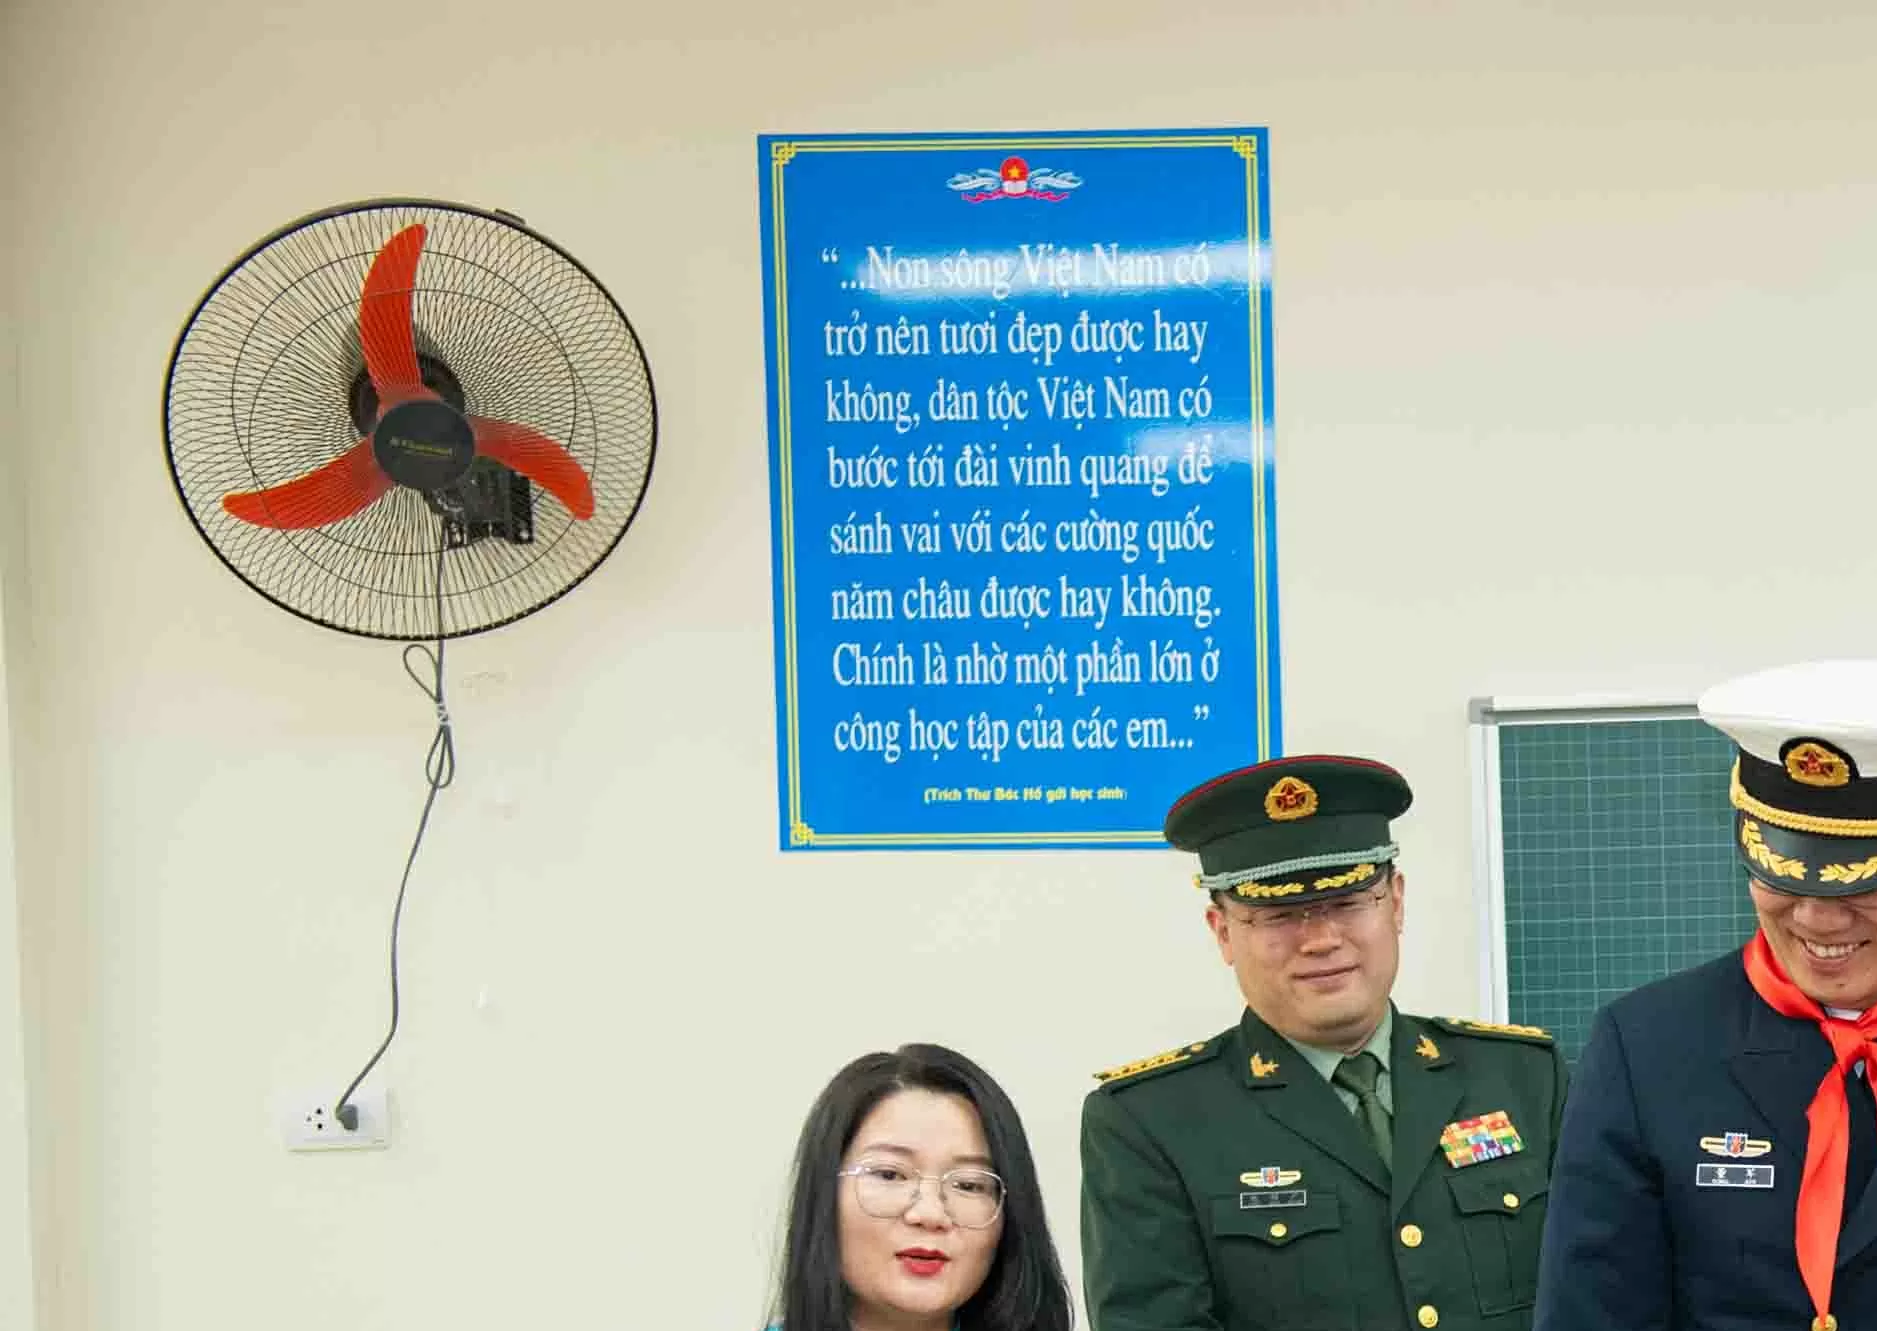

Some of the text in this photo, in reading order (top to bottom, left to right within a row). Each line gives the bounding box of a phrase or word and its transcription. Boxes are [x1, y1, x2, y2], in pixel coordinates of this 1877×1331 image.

[939, 250, 1011, 298] sông
[1019, 242, 1081, 297] Việt
[1093, 243, 1164, 286] Nam
[1173, 242, 1209, 284] có
[824, 309, 1208, 365] trở nên tươi đẹp được hay
[825, 375, 1212, 434] không, dân tộc Việt Nam có
[827, 433, 1213, 498] bước tới đài vinh quang để
[830, 505, 1214, 563] sánh vai với các cường quốc
[831, 574, 1221, 628] năm châu được hay không.
[833, 636, 1220, 695] Chính là nhờ một phần lớn ở
[834, 711, 901, 763] công
[910, 707, 959, 760] học
[967, 709, 1009, 760] tập
[1017, 704, 1064, 751] của
[1072, 708, 1117, 750] các
